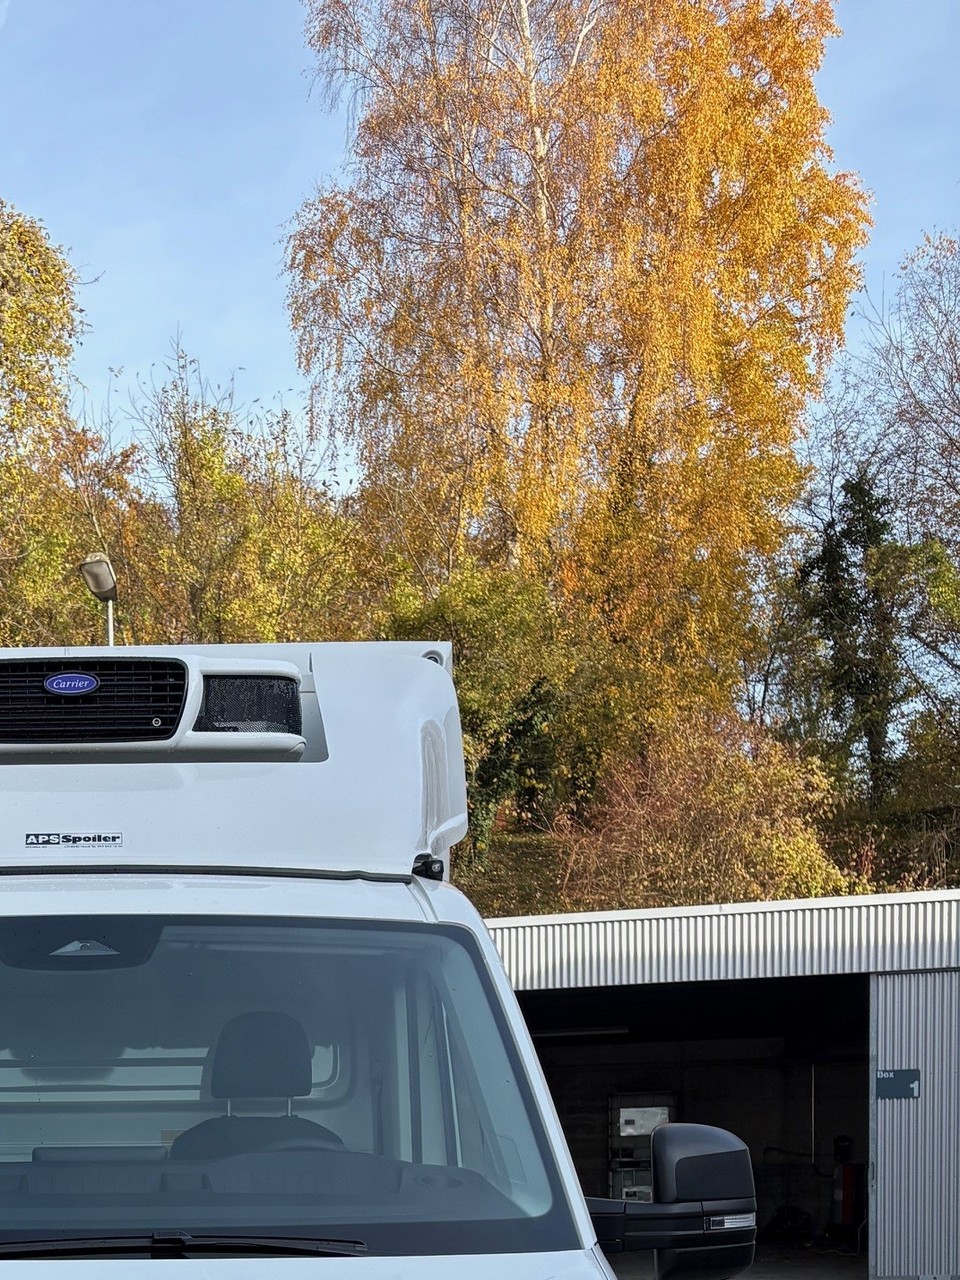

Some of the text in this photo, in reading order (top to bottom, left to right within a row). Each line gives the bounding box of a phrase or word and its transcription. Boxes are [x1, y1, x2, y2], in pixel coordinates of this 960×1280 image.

[53, 679, 90, 689] Carrier
[26, 834, 121, 844] APS Spoiler
[910, 1081, 919, 1096] 1
